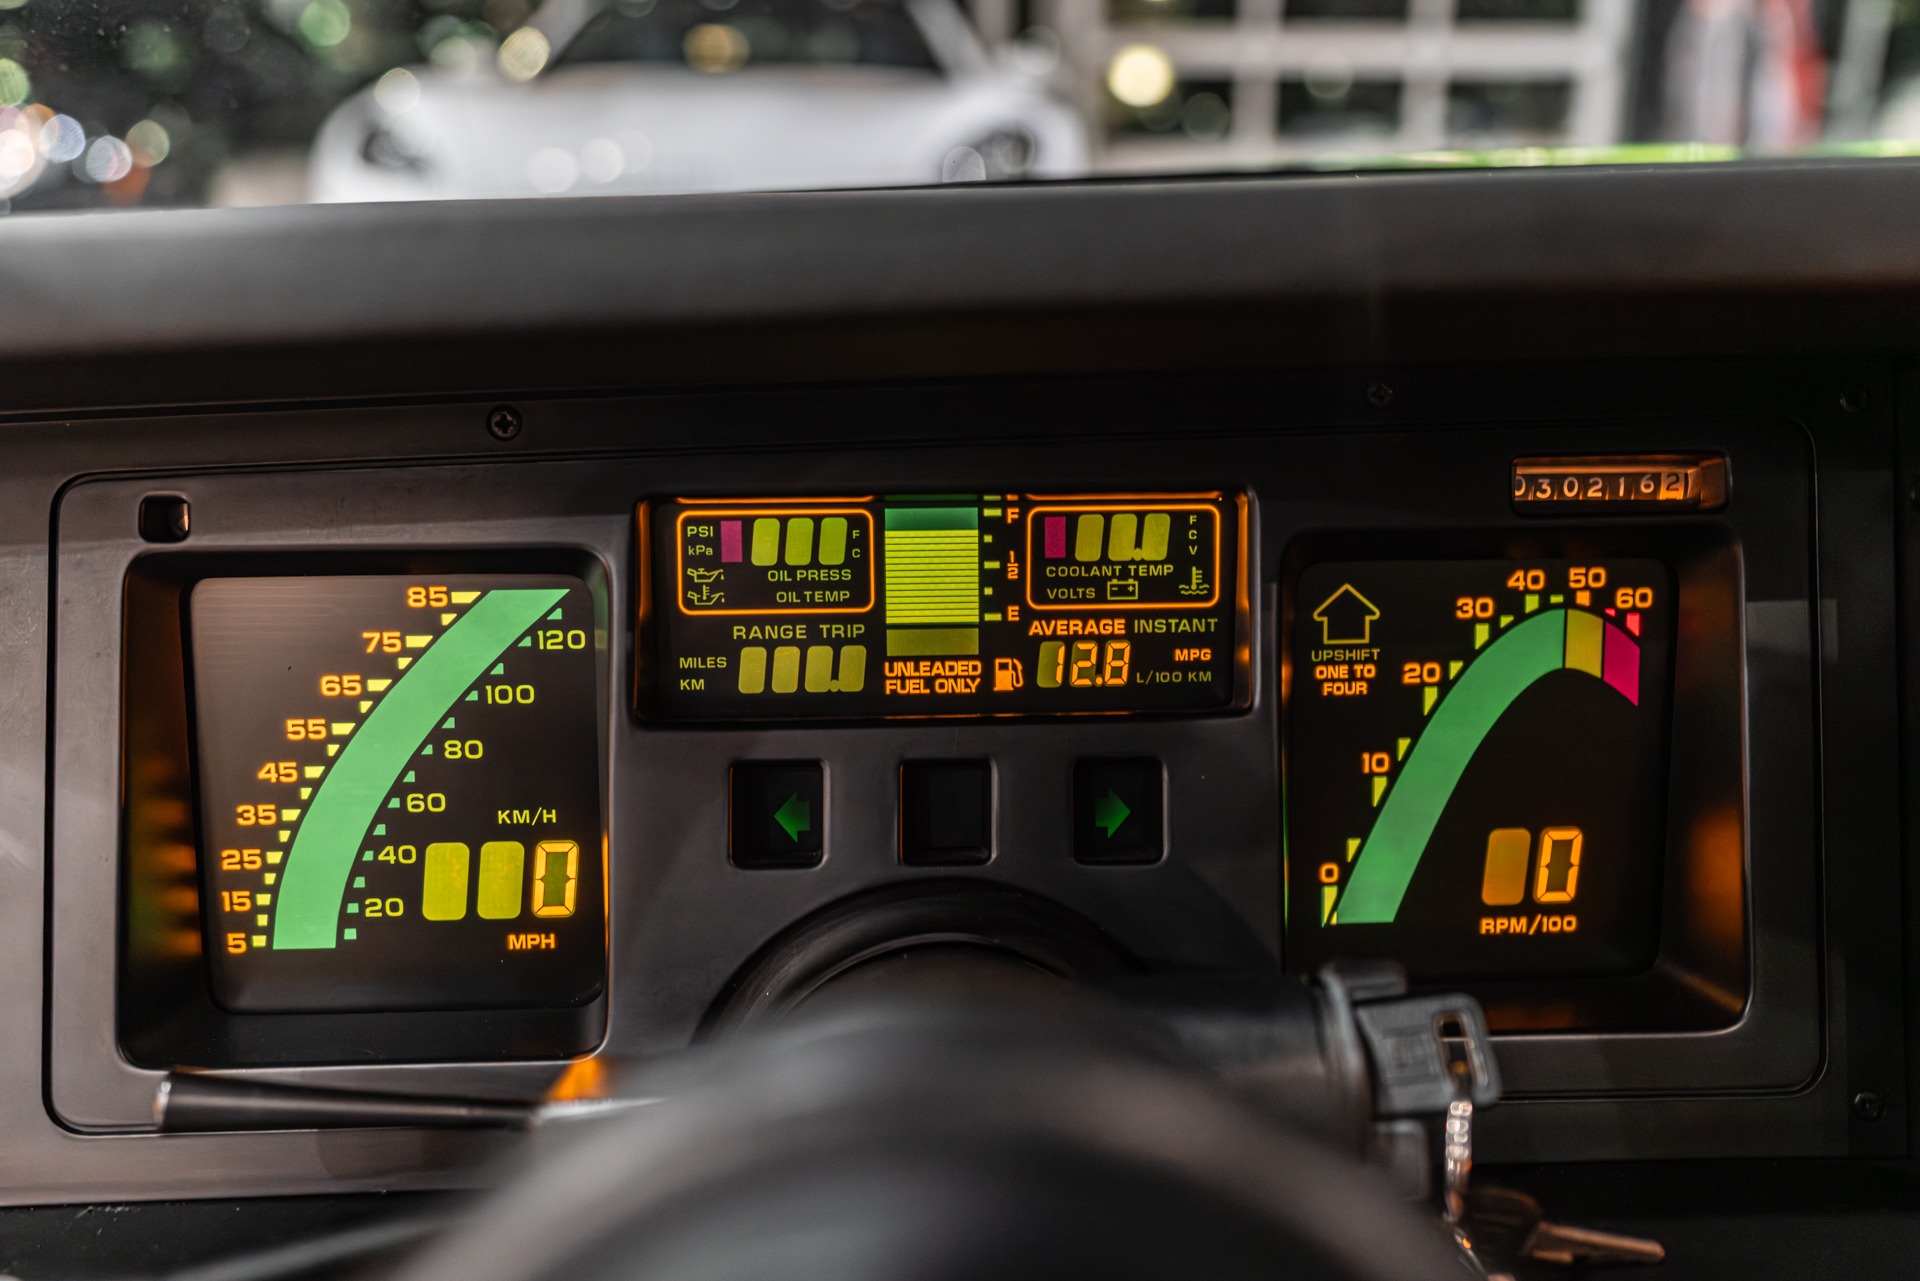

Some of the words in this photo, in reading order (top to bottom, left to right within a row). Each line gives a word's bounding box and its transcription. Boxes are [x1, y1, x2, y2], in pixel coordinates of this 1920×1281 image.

[1007, 508, 1020, 524] F
[1189, 515, 1197, 525] F
[687, 526, 714, 537] PSI
[852, 530, 860, 539] F
[1188, 530, 1197, 540] C
[688, 545, 714, 556] kPa
[852, 549, 860, 558] C
[1189, 546, 1198, 555] V
[767, 570, 792, 582] OIL
[796, 569, 852, 581] PRESS
[1046, 565, 1122, 578] COOLANT
[1128, 564, 1174, 576] TEMP
[1507, 569, 1546, 590] 40
[1568, 567, 1606, 588] 50
[407, 586, 448, 608] 85
[776, 591, 800, 603] OIL
[804, 590, 850, 602] TEMP
[1047, 588, 1096, 599] VOLTS
[1615, 587, 1653, 609] 60
[1007, 605, 1020, 621] E
[1455, 597, 1494, 619] 30
[733, 625, 807, 640] RANGE
[820, 624, 865, 639] TRIP
[1028, 619, 1126, 636] AVERAGE
[1134, 618, 1218, 634] INSTANT
[362, 631, 401, 654] 75
[537, 629, 586, 651] 120
[679, 656, 727, 669] MILES
[1055, 640, 1131, 687] 12.8
[1175, 649, 1212, 662] MPG
[1311, 648, 1381, 662] UPSHIFT
[884, 659, 981, 678] UNLEADED
[1136, 670, 1182, 684] L/100
[1188, 671, 1212, 683] KM
[1315, 665, 1349, 680] ONE
[1353, 664, 1376, 679] TO
[1402, 662, 1441, 684] 20
[320, 674, 361, 697] 65
[680, 679, 705, 691] KM
[885, 679, 930, 695] FUEL
[934, 678, 981, 694] ONLY
[1322, 681, 1368, 696] FOUR
[485, 684, 535, 705] 100
[286, 718, 327, 741] 55
[444, 740, 483, 760] 80
[1361, 752, 1390, 774] 10
[257, 762, 298, 783] 45
[406, 793, 446, 813] 60
[236, 805, 277, 826] 35
[497, 808, 557, 826] KM/H
[221, 849, 262, 871] 25
[378, 845, 417, 865] 40
[1319, 862, 1339, 883] 0
[1533, 826, 1583, 904] 0
[532, 840, 579, 918] 0
[221, 891, 251, 912] 15
[365, 898, 404, 917] 20
[1479, 914, 1577, 935] RPM/100
[226, 933, 247, 954] 5
[507, 933, 556, 950] MPH
